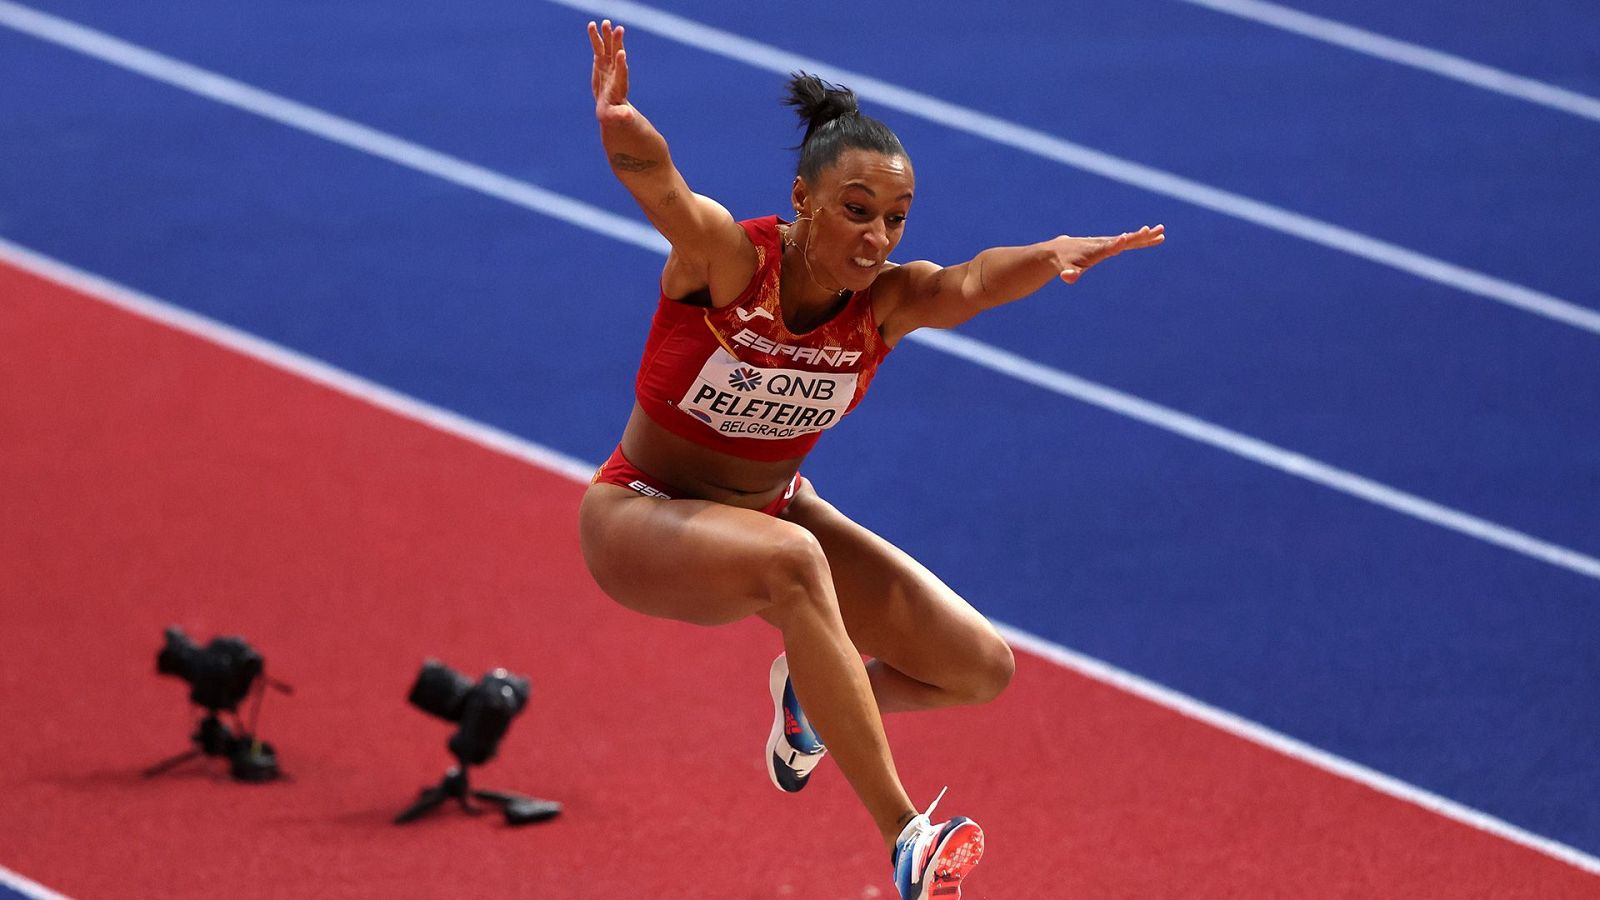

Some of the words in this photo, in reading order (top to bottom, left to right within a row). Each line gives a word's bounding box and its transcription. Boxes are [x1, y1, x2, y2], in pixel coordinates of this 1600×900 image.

[731, 328, 862, 367] ESPAÑA
[693, 384, 836, 427] PELETEIRO
[767, 375, 836, 400] QNB
